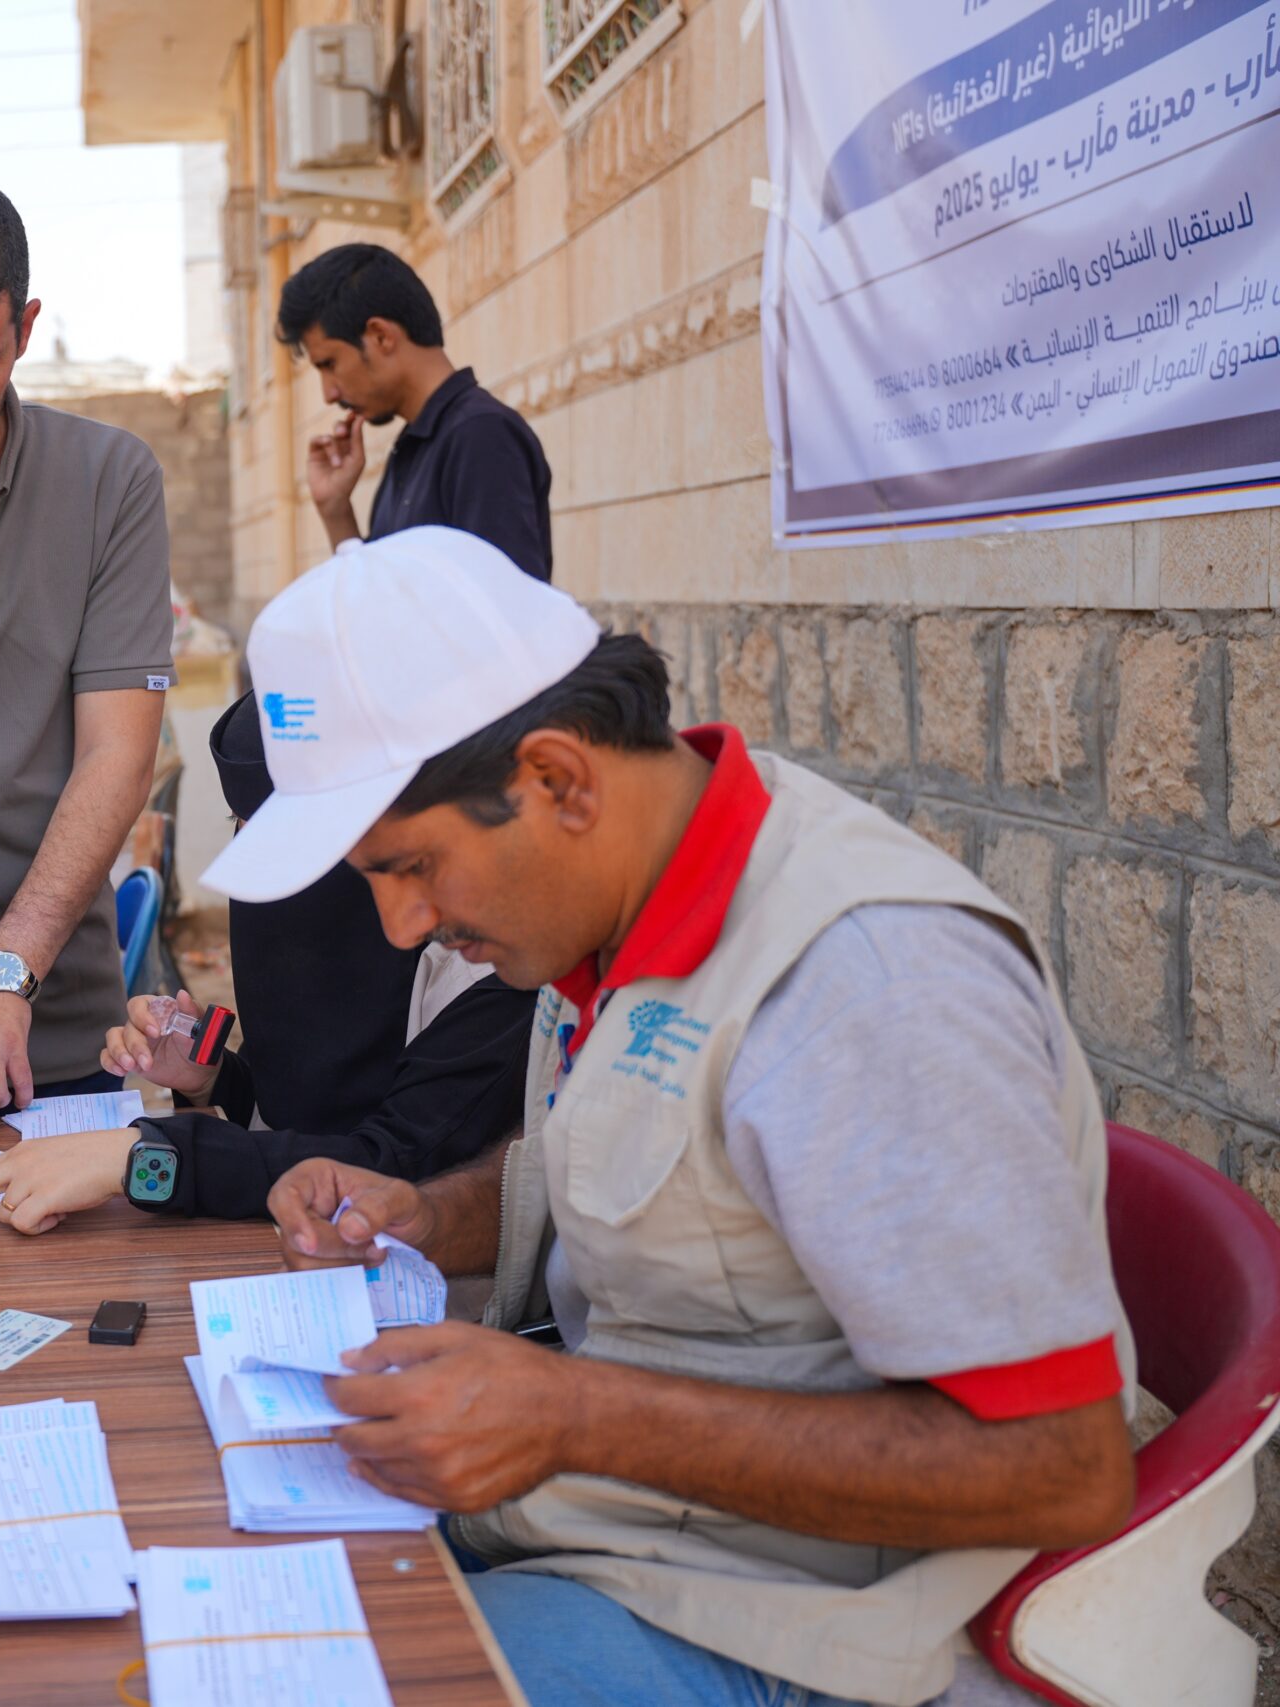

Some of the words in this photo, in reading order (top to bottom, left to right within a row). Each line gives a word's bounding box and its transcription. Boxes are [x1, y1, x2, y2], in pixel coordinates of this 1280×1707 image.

[1225, 12, 1280, 107] أرب
[1064, 101, 1118, 179] مأرب
[1126, 87, 1195, 145] مدينة
[934, 170, 984, 238] 2025م
[989, 155, 1039, 211] يوليو
[1163, 191, 1254, 261] لاستقبال
[1001, 256, 1081, 306] والمقترحات
[1084, 226, 1157, 287] الشكاوى
[941, 346, 1002, 386] 8000664
[1144, 341, 1207, 395] التمويل
[1210, 330, 1280, 380] صندوق
[947, 392, 1006, 430] 8001234
[1026, 379, 1061, 421] اليمن
[1077, 359, 1140, 417] الإنساني
